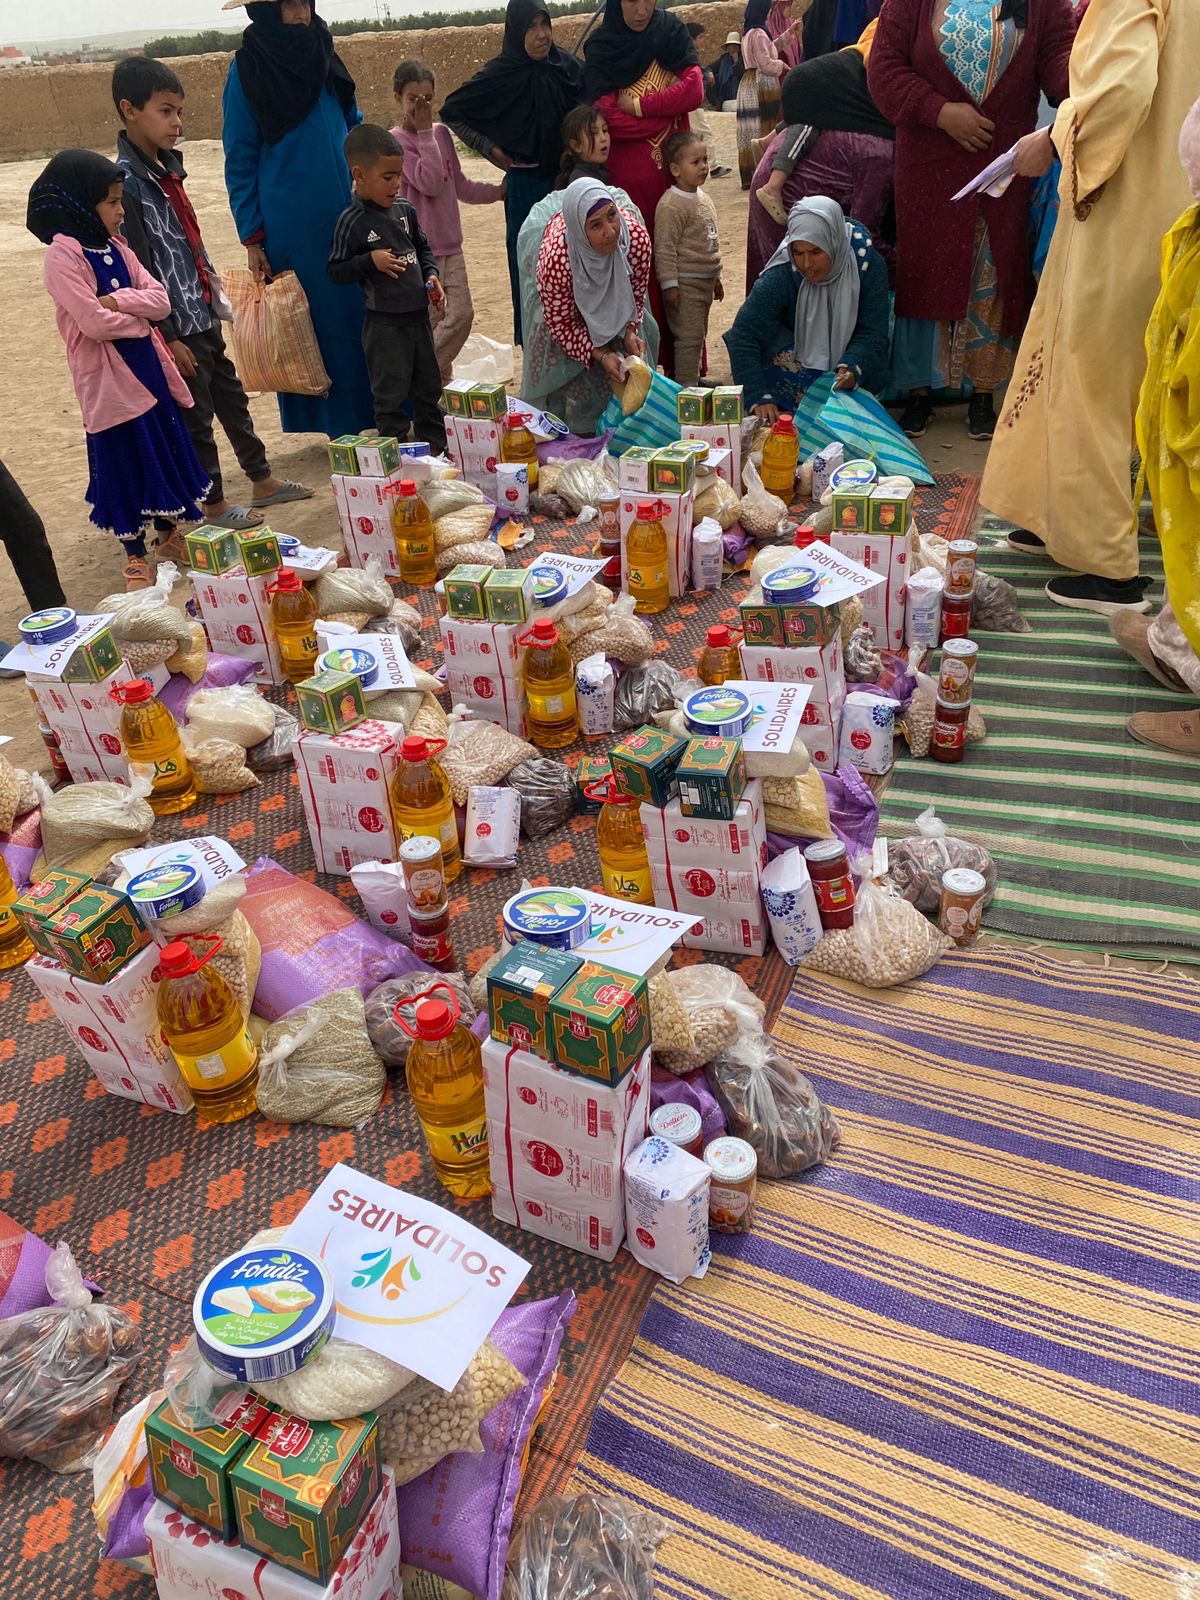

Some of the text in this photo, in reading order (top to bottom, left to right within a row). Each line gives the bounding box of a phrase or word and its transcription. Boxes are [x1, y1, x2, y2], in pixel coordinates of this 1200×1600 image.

[406, 542, 429, 555] Hala
[807, 548, 873, 587] SOLIDAIRES
[44, 617, 104, 669] SOLIDAIRES
[379, 637, 405, 685] SOLIDAIRES
[699, 691, 739, 701] Fondiz
[761, 687, 799, 747] SOLIDAIRES
[189, 839, 233, 880] SOLIDAIRES
[140, 865, 184, 881] Fondiz
[159, 898, 180, 912] Fondiz
[591, 902, 685, 930] SOLIDAIR
[516, 914, 568, 929] Fondiz
[327, 1188, 507, 1288] SOLIDAIRES
[230, 1258, 310, 1283] Fondiz
[174, 1454, 191, 1469] TAJ
